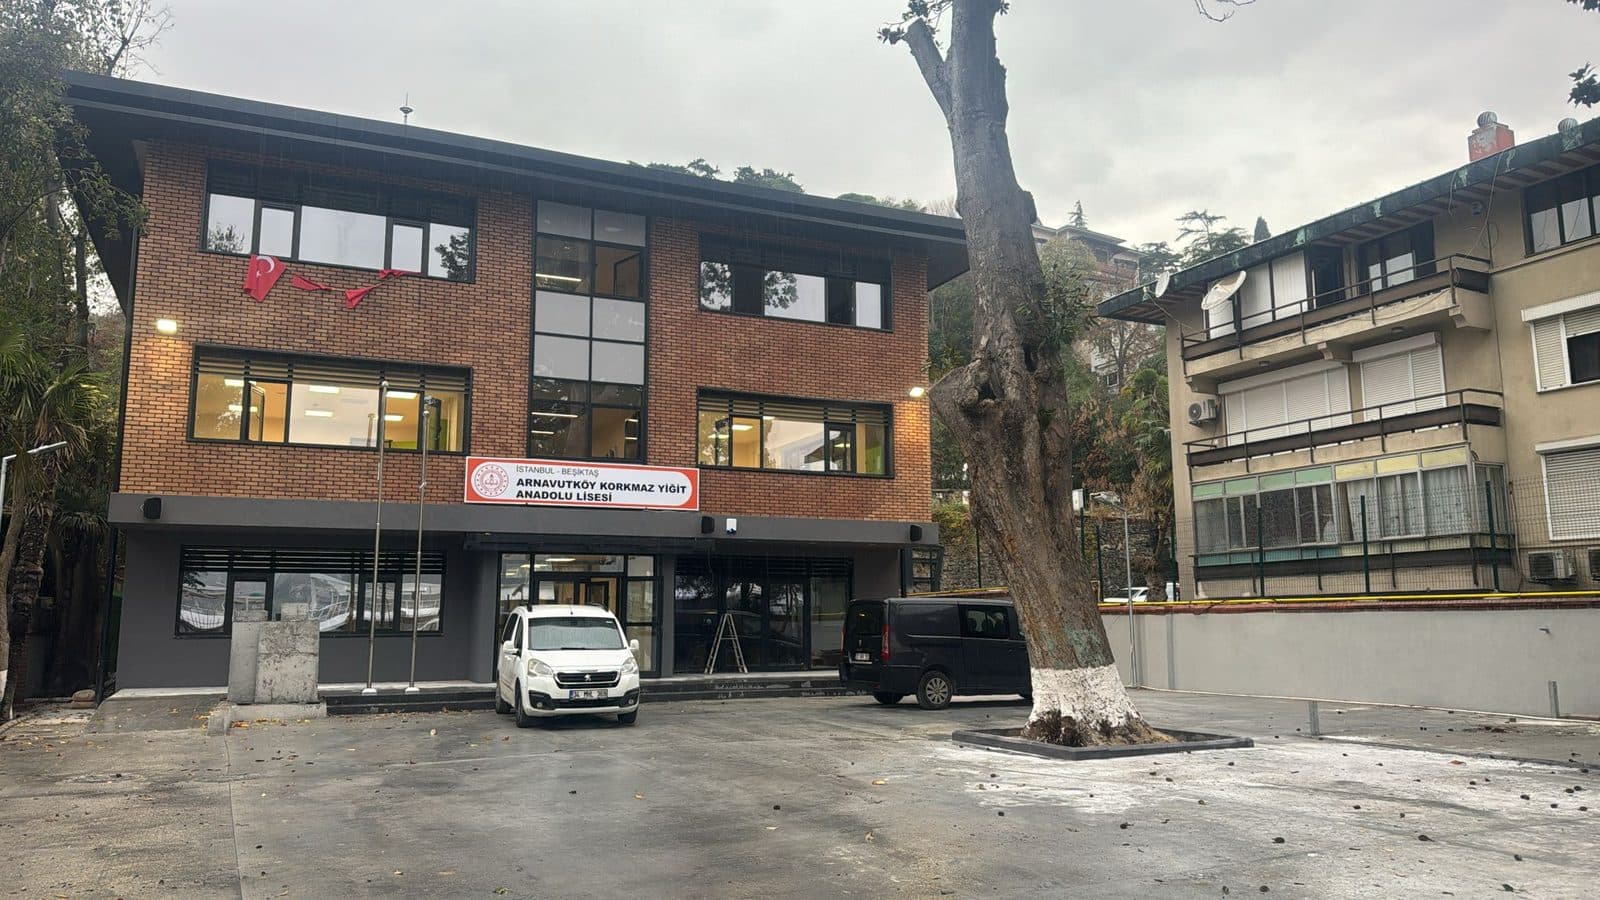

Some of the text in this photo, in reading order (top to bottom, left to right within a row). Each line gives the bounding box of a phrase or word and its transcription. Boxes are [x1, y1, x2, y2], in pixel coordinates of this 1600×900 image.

[516, 464, 555, 475] İSTANBUL
[561, 467, 600, 478] BEŞİKTAŞ
[516, 478, 597, 490] ARNAVUTKÖY
[600, 481, 654, 493] KORKMAZ
[658, 483, 687, 494] YİĞİT
[516, 490, 612, 502] ANADOLU LİSESİ
